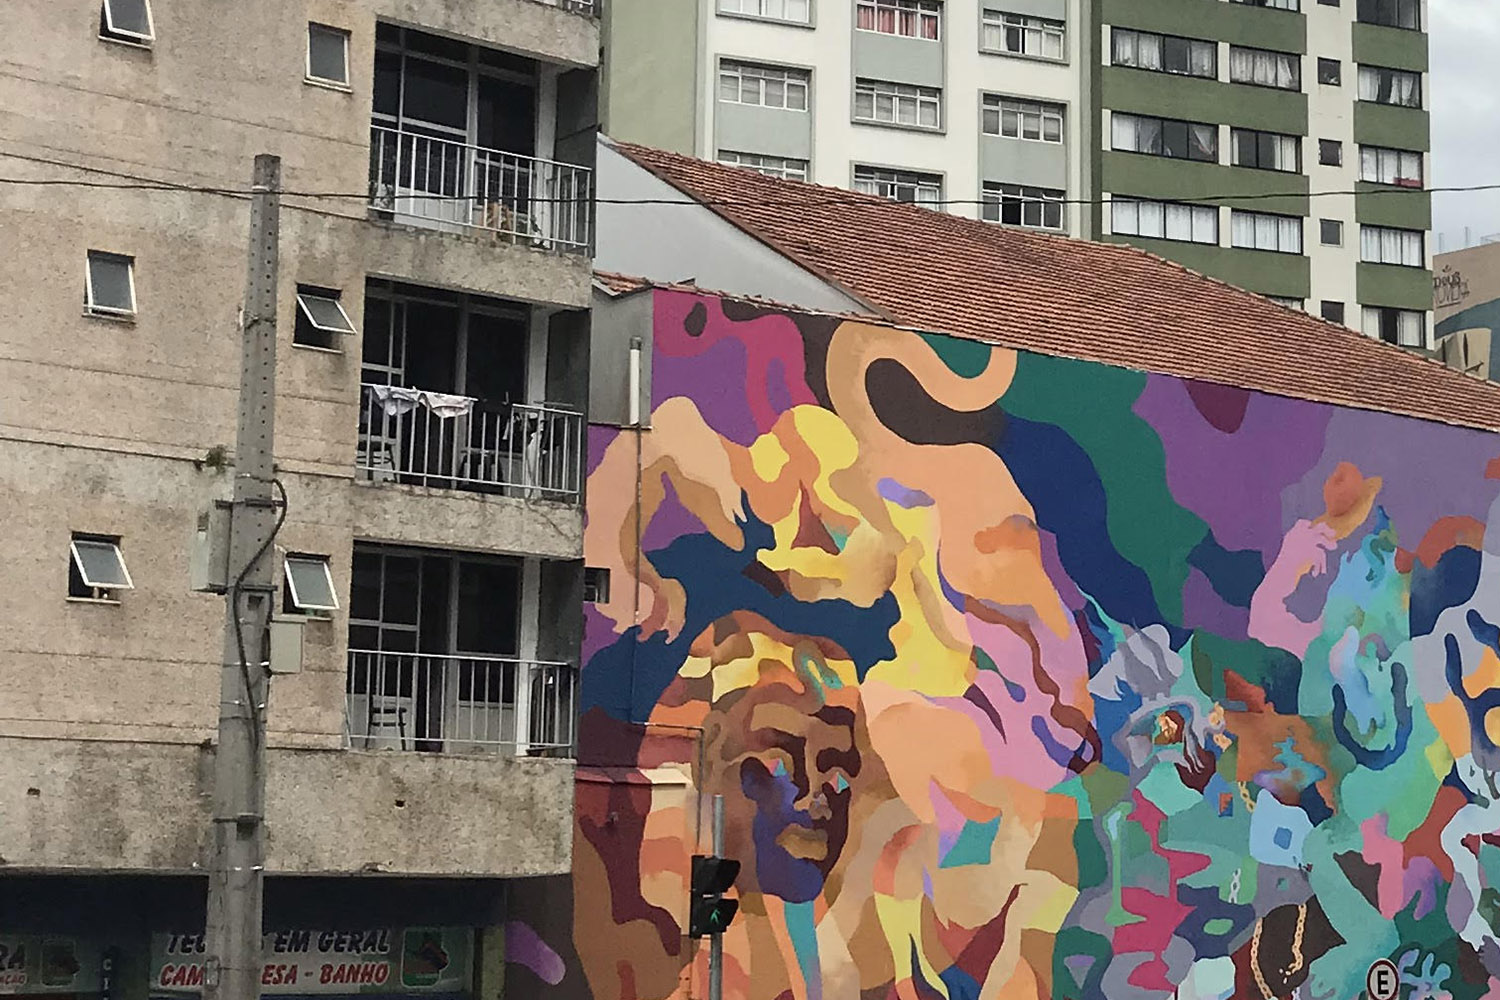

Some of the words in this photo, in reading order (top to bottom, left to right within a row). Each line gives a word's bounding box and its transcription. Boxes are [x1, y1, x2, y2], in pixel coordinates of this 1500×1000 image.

[318, 929, 390, 953] GERAL
[319, 963, 389, 985] BANHO
[1377, 970, 1389, 995] E
